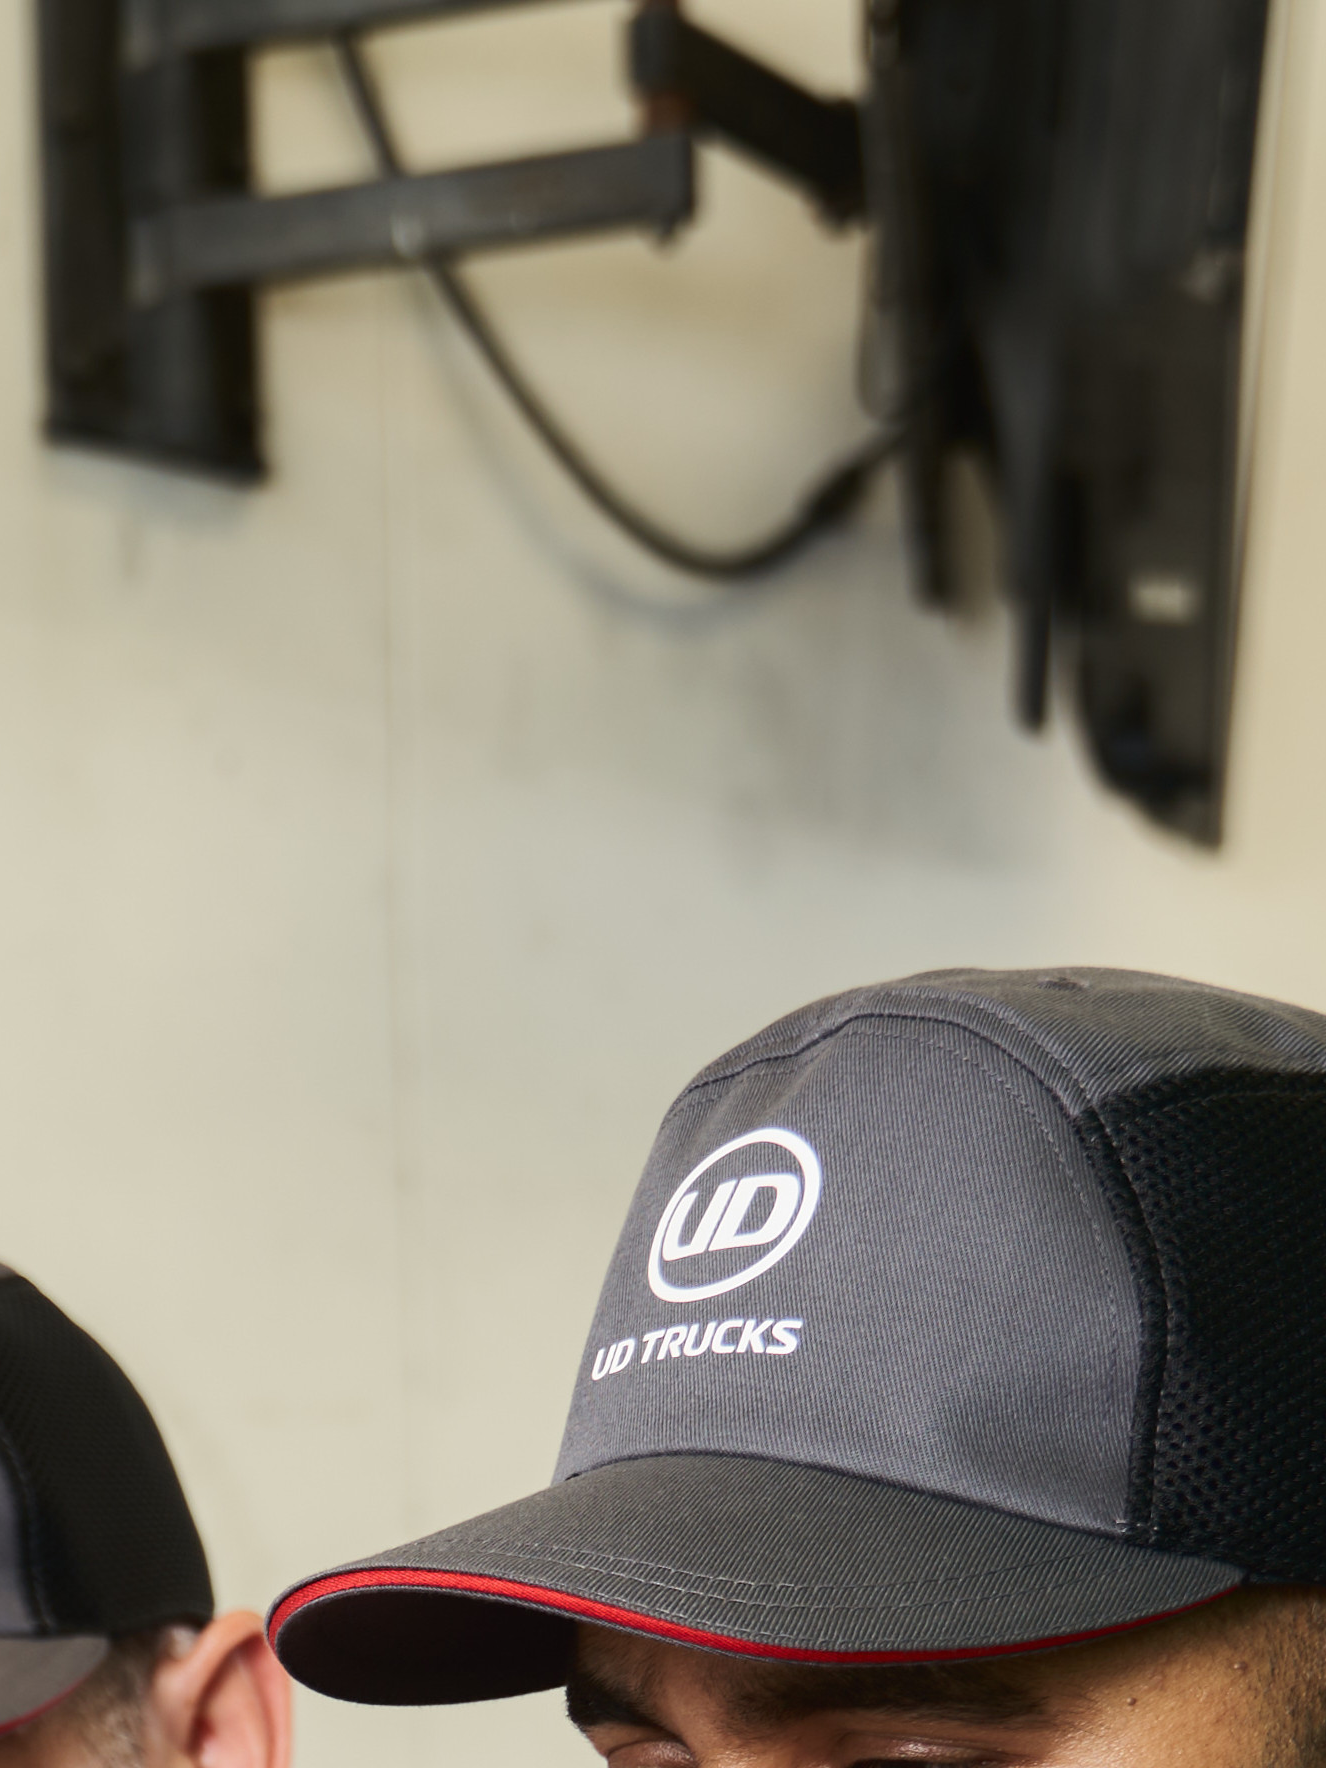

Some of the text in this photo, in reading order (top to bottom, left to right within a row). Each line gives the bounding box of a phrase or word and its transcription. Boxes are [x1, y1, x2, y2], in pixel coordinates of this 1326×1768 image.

[661, 1174, 800, 1262] UD
[590, 1317, 803, 1381] UD TRUCKS
